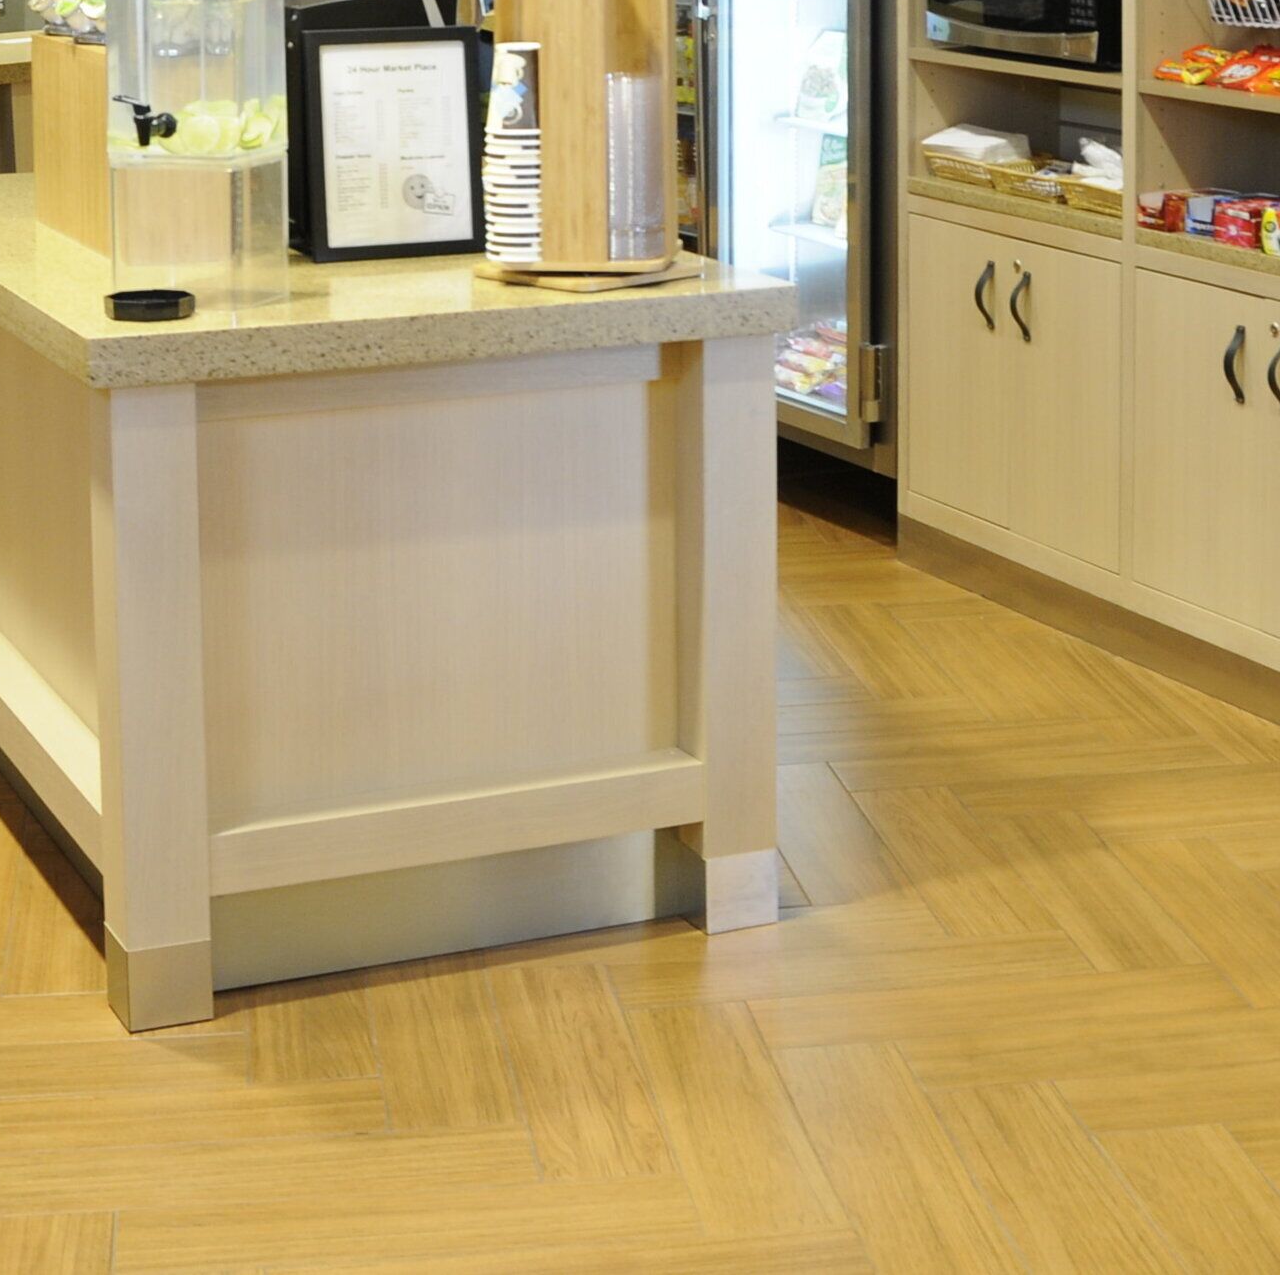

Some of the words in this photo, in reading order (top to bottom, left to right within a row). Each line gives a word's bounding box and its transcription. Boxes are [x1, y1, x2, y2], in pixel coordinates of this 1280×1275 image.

[347, 65, 358, 74] 24
[383, 63, 412, 73] Market
[414, 62, 437, 71] Place
